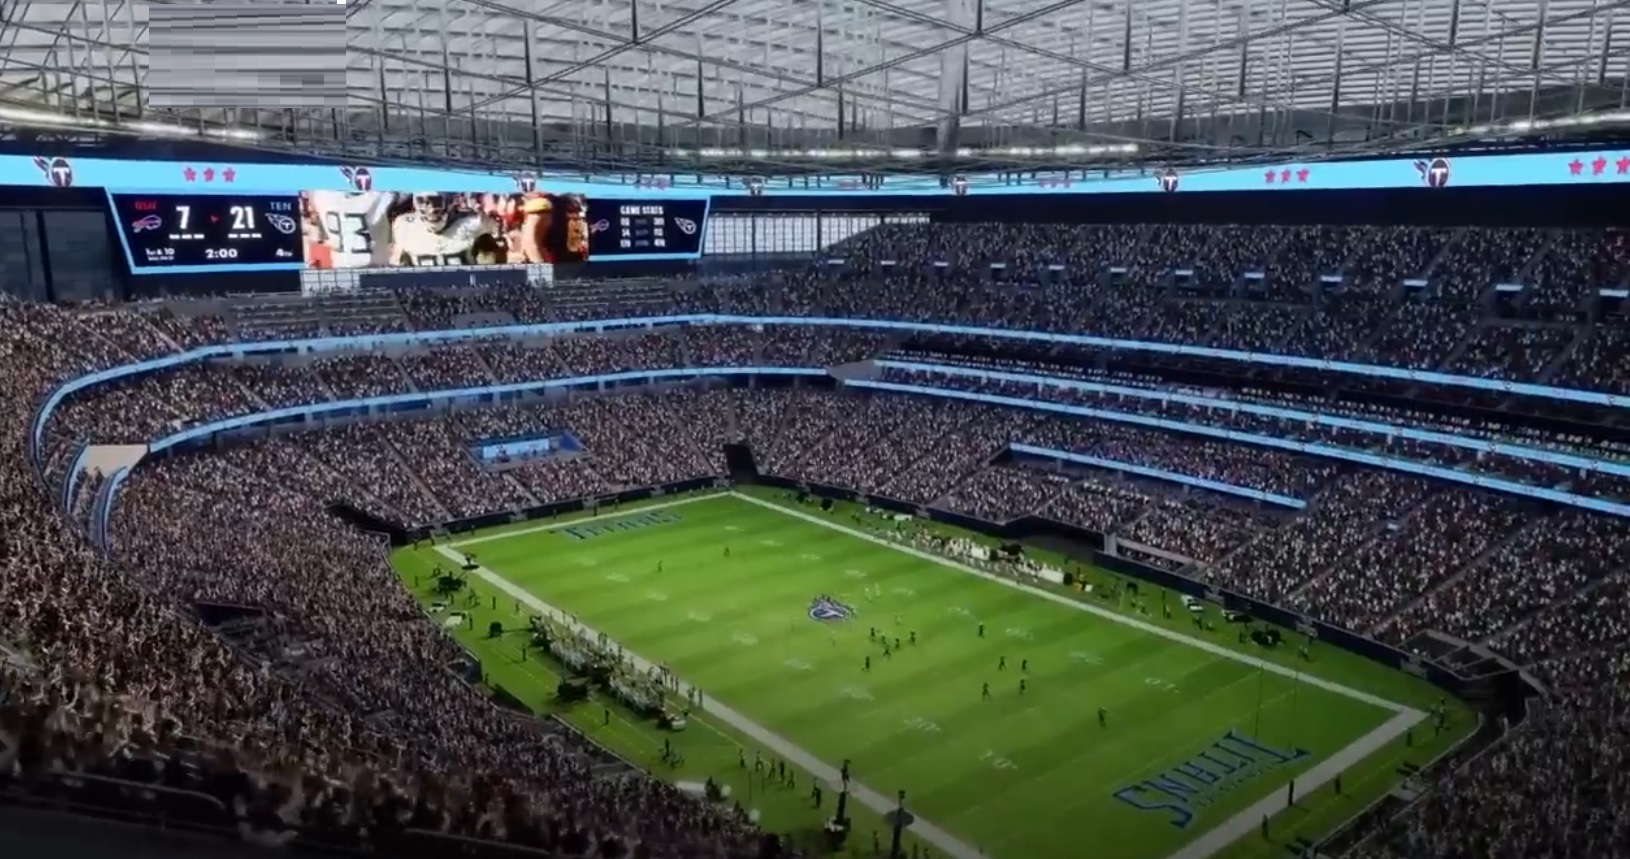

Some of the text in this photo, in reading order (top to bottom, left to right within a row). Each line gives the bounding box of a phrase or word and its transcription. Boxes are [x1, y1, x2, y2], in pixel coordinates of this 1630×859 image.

[175, 205, 191, 230] 7
[229, 205, 255, 230] 21
[270, 202, 292, 211] TEN
[620, 205, 664, 215] GAME STATS
[325, 211, 374, 254] 93
[205, 248, 238, 258] 2:00
[1112, 728, 1312, 829] TITANS
